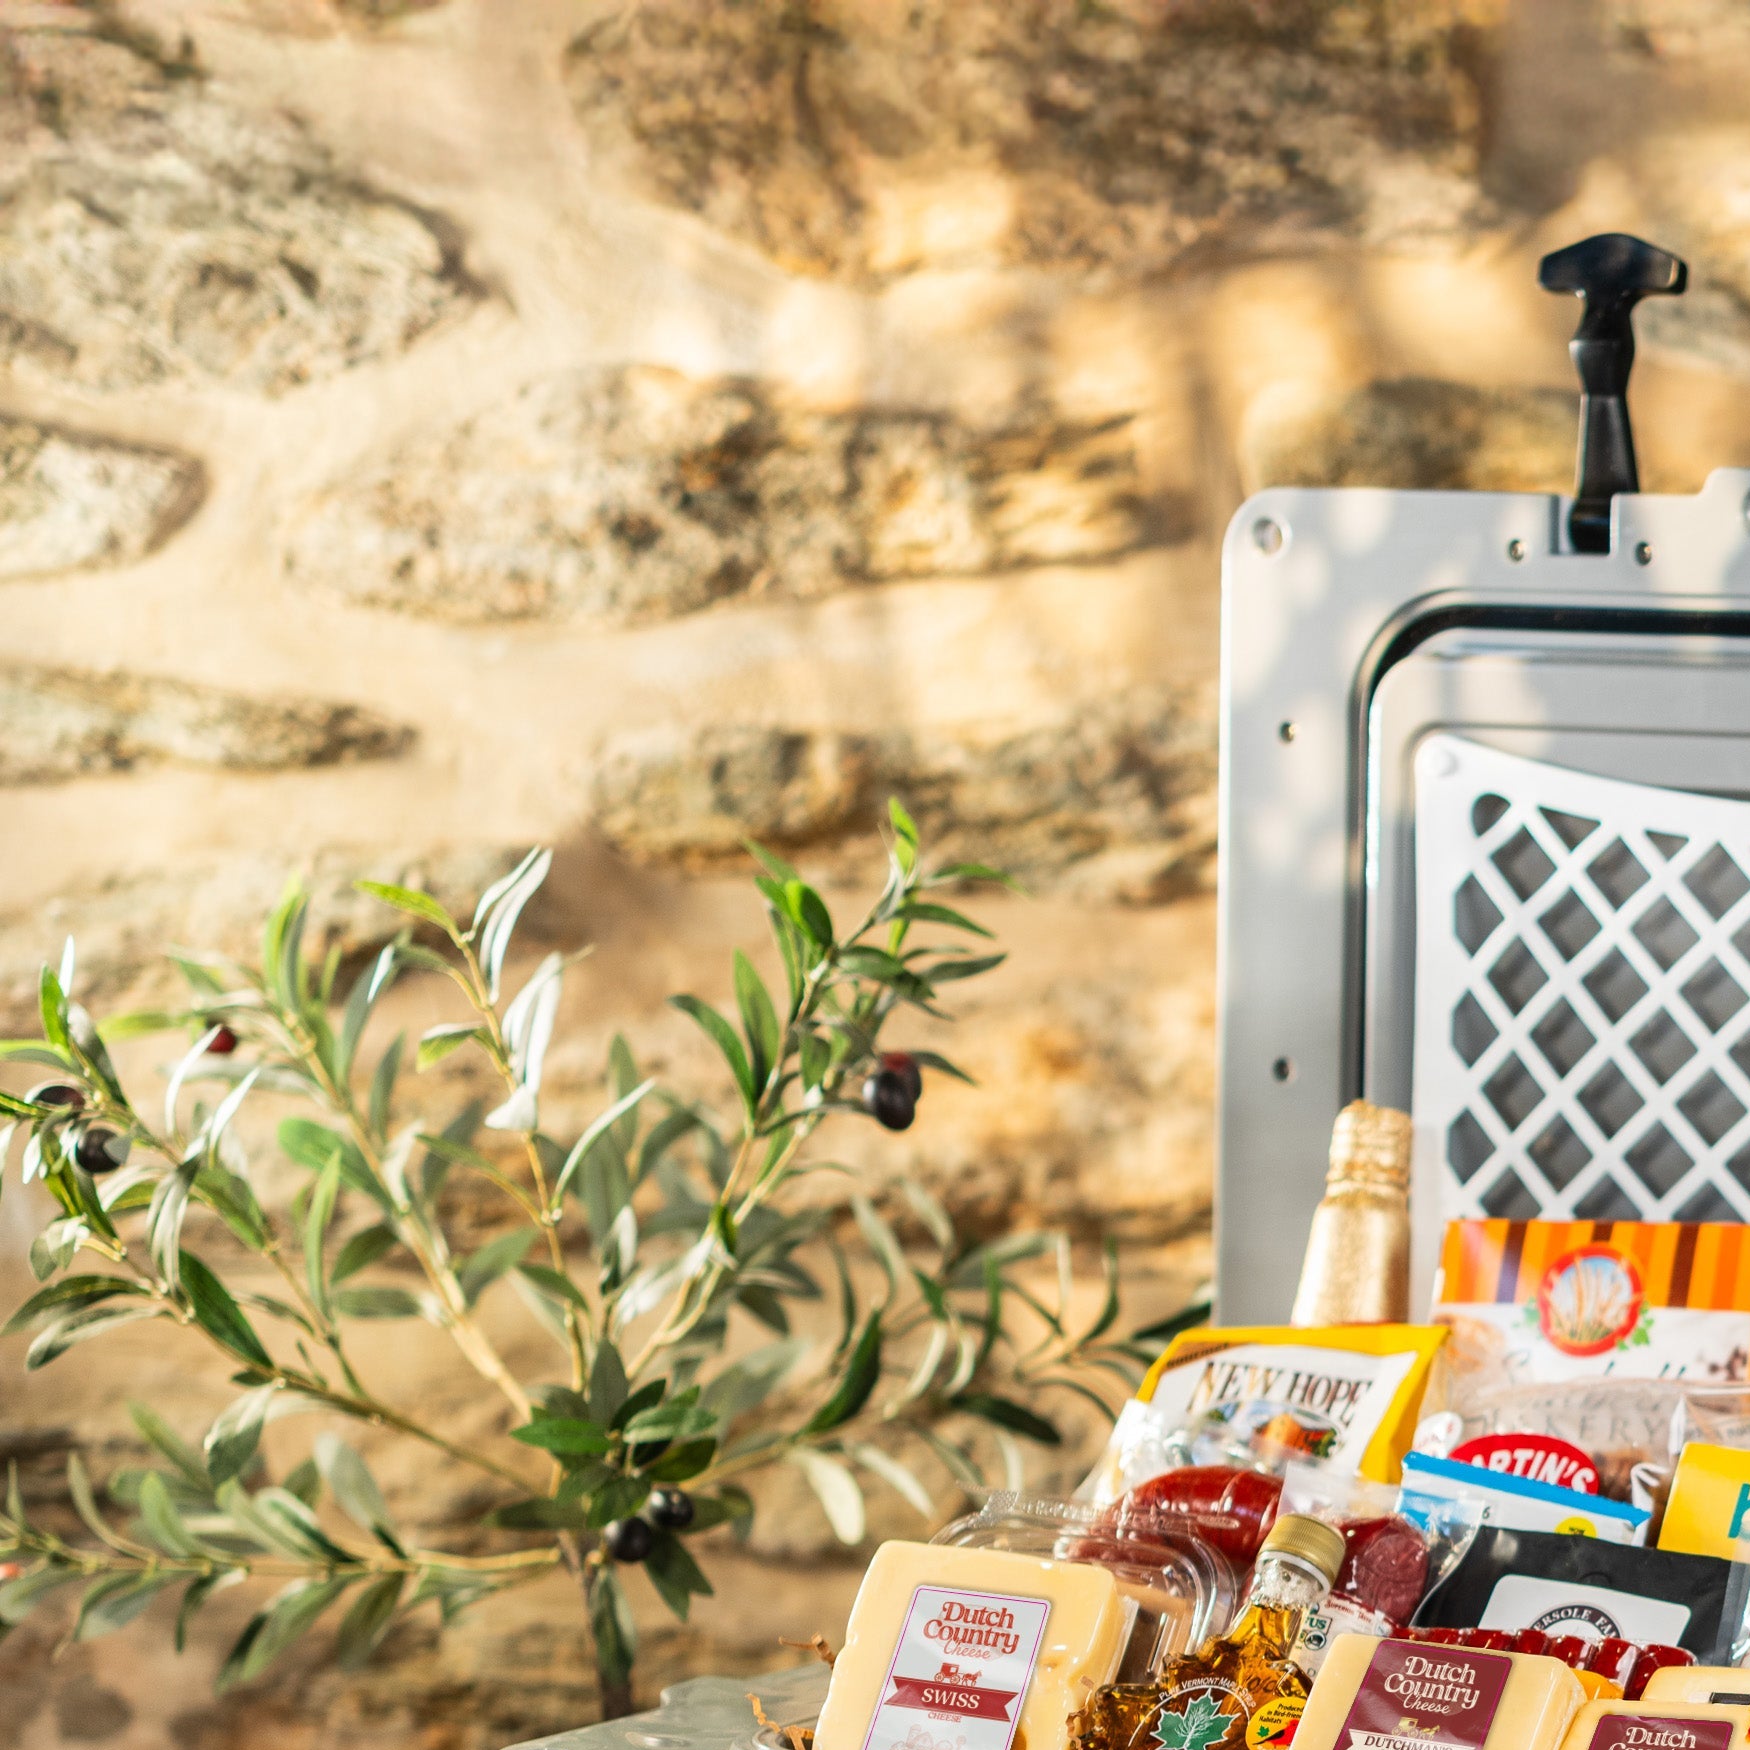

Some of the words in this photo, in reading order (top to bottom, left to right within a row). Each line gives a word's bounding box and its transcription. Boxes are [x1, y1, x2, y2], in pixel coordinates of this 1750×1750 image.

[1186, 1358, 1283, 1414] NEW
[1286, 1371, 1374, 1427] HOPE
[942, 1601, 1015, 1629] Dutch
[923, 1619, 1020, 1654] Country
[943, 1639, 992, 1660] Cheese
[1405, 1656, 1477, 1685] Dutch
[1181, 1676, 1220, 1689] VERMONT
[1383, 1673, 1481, 1709] Country
[921, 1687, 981, 1709] SWISS
[1402, 1692, 1451, 1715] Cheese
[927, 1712, 962, 1723] CHEESE
[1273, 1709, 1302, 1719] Bird-frien
[1625, 1726, 1697, 1749] Dutch
